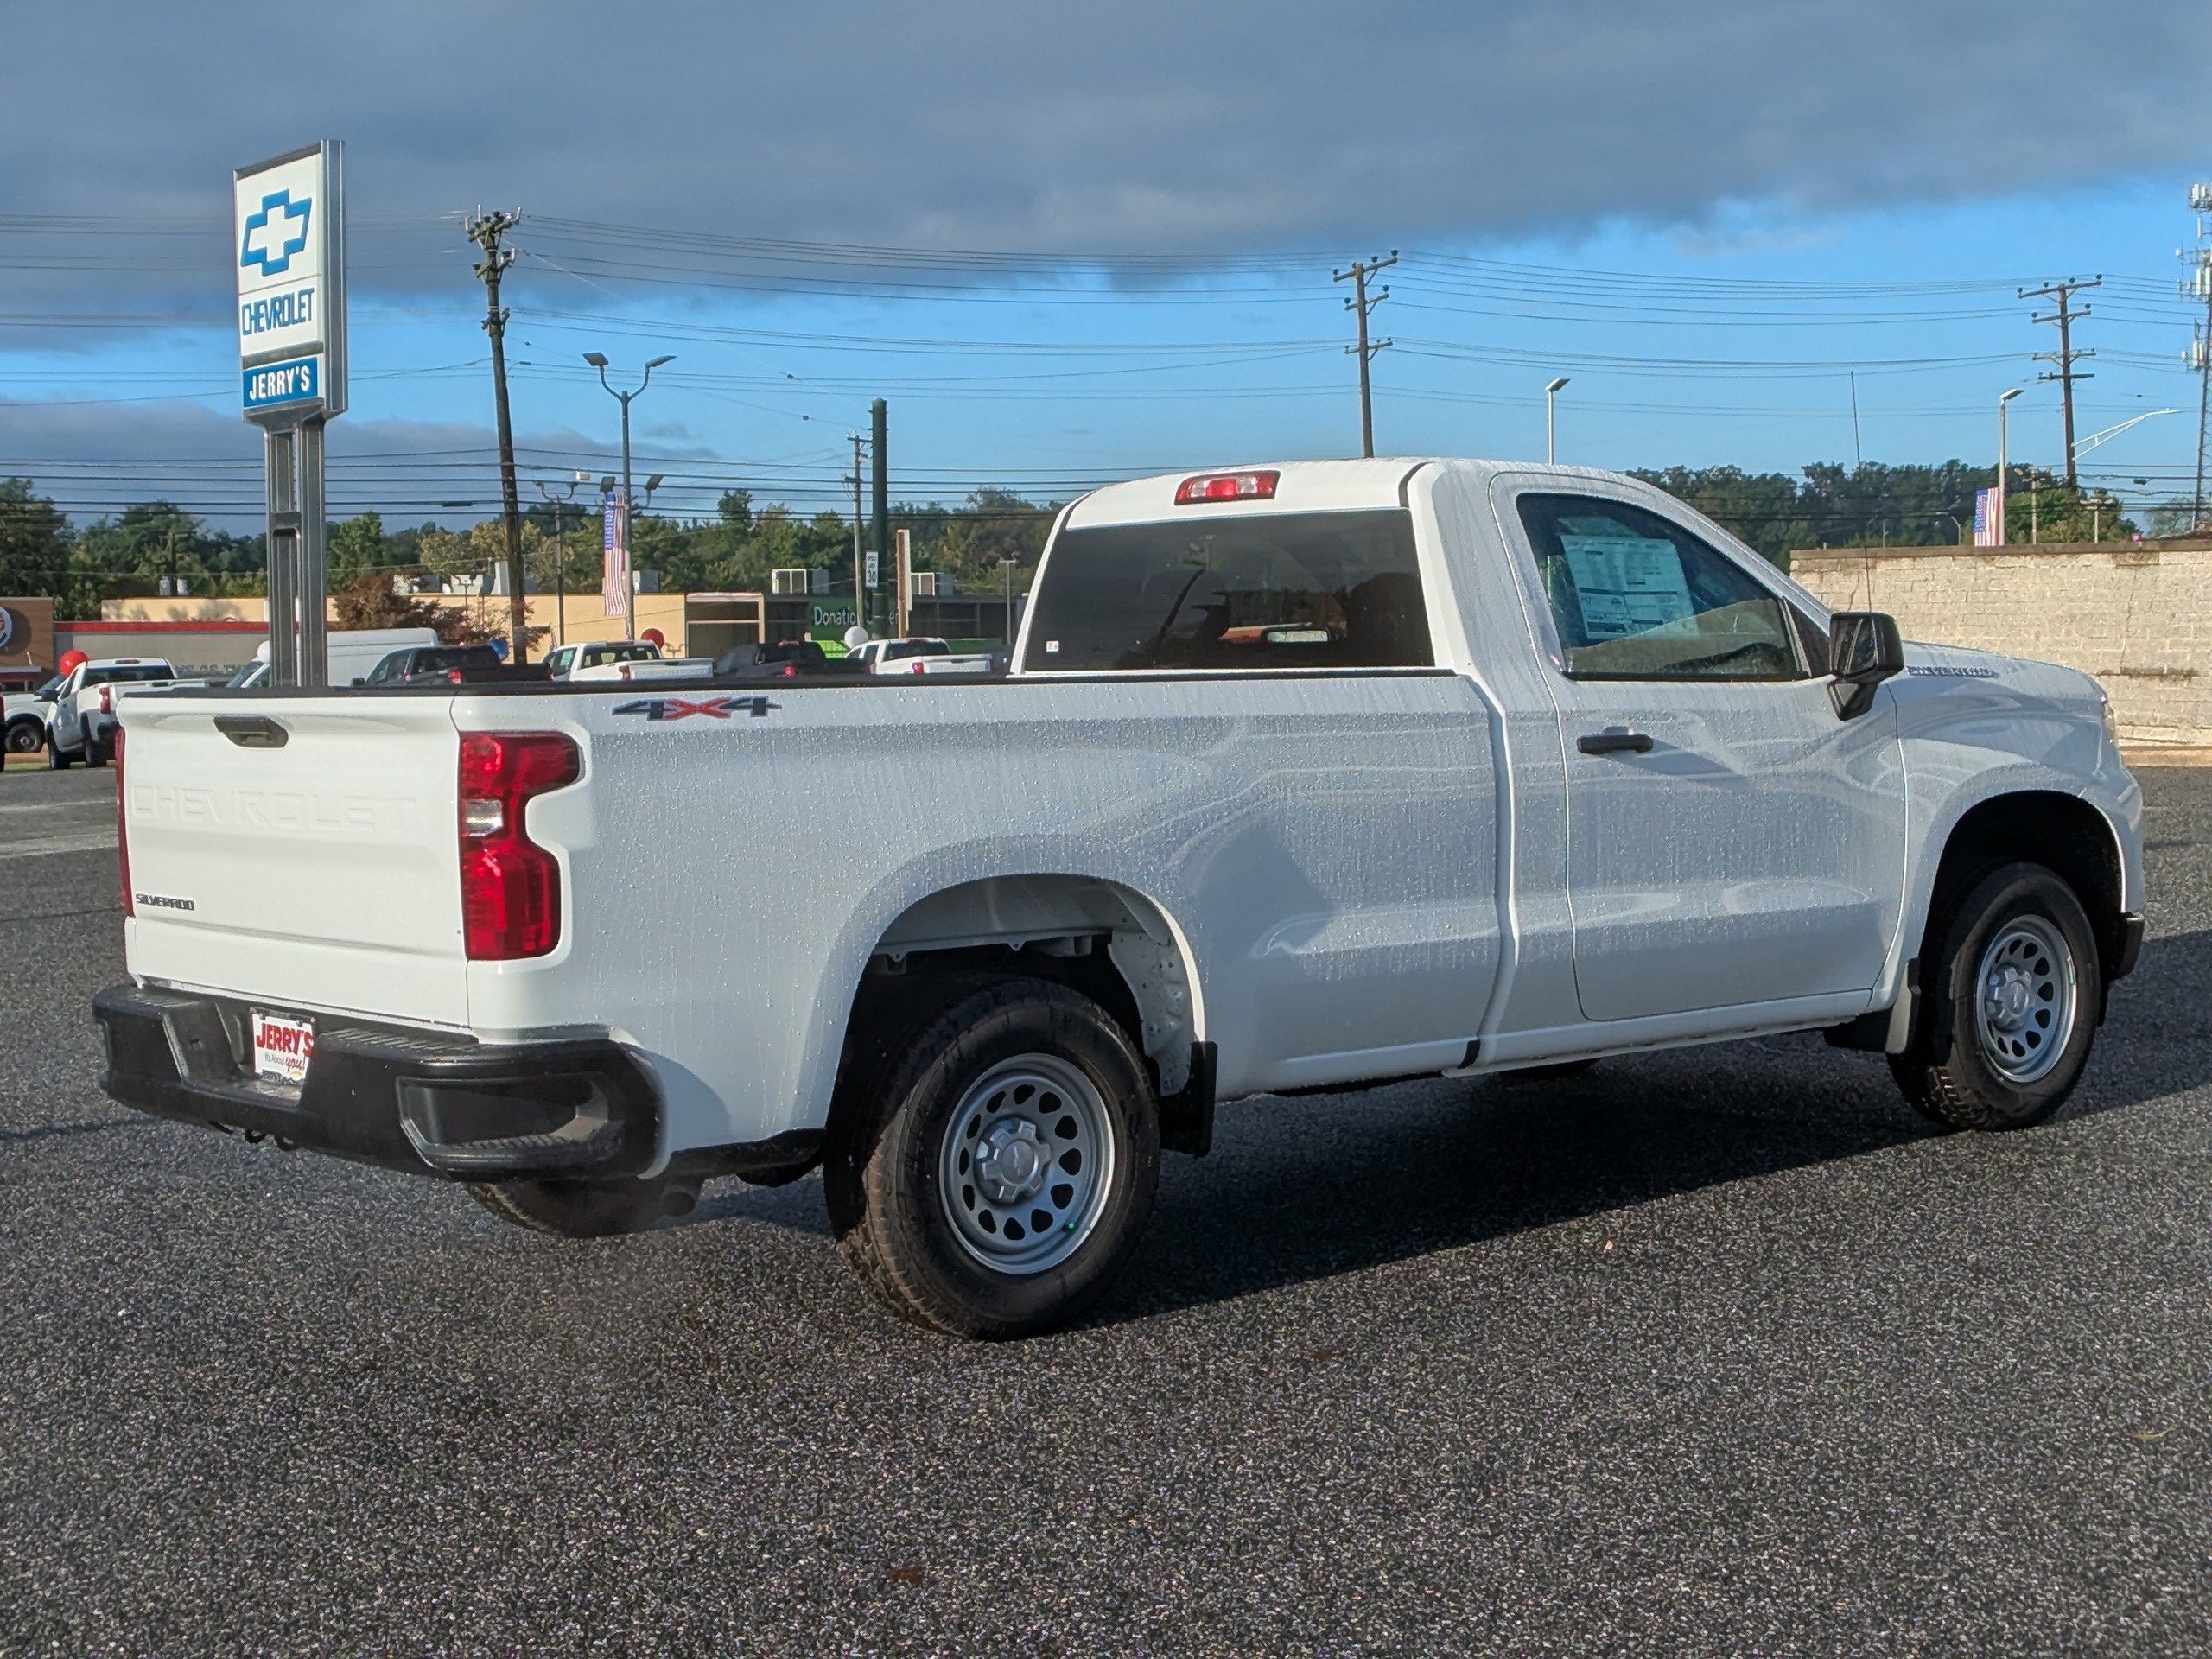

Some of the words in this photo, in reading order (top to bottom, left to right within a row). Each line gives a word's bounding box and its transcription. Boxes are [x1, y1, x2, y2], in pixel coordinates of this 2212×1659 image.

[241, 287, 315, 336] CHEVROLET
[249, 365, 310, 401] JERRY'S
[868, 570, 877, 583] 30
[131, 785, 416, 834] CHEVROLET
[136, 893, 195, 912] SILVERADO
[256, 1023, 315, 1058] JERRY'S
